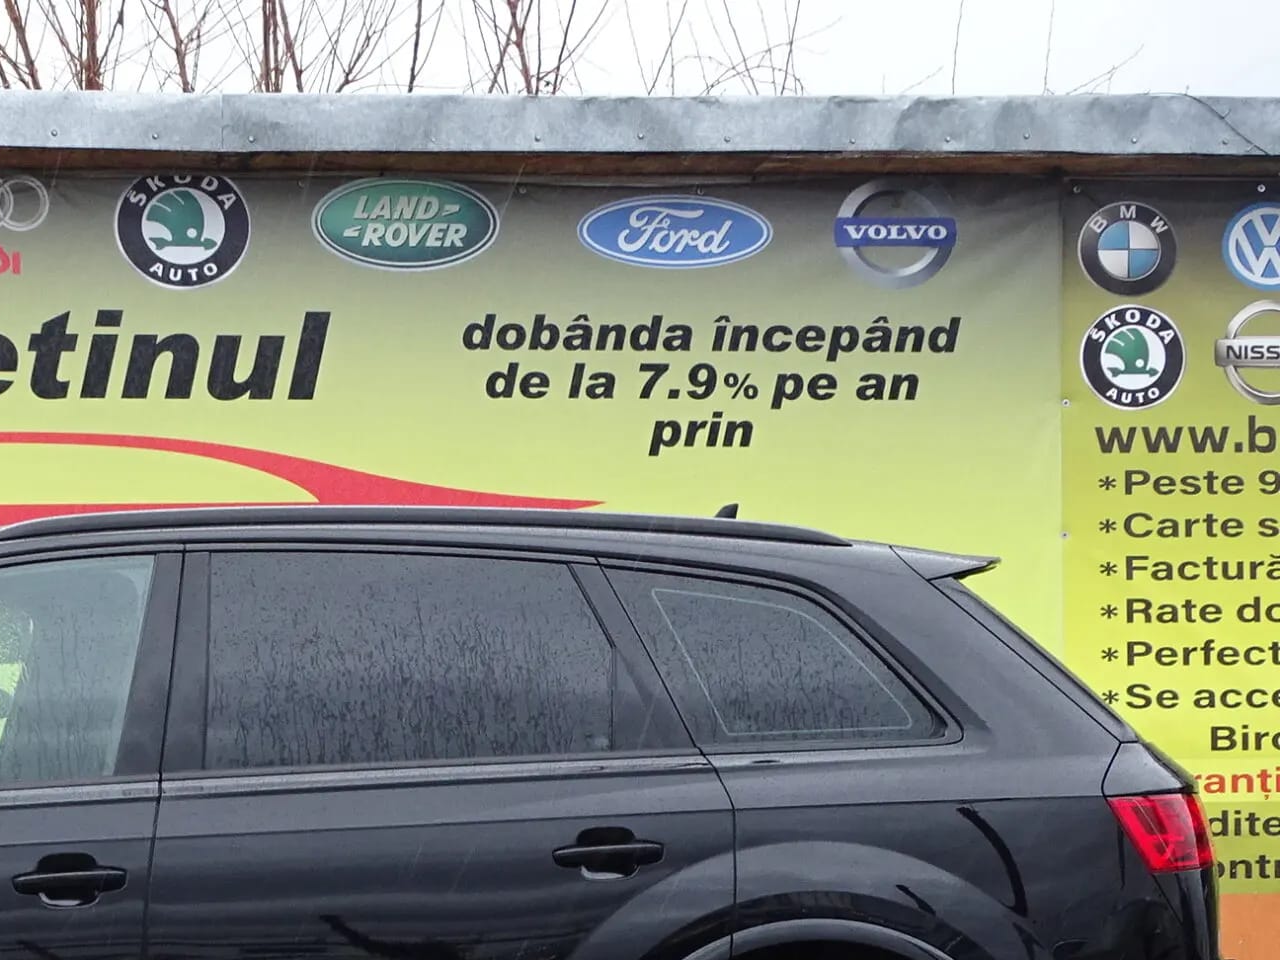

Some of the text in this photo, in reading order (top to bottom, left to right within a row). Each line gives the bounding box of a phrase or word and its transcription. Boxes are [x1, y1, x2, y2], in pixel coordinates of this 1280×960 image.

[353, 194, 439, 221] LAND
[1089, 205, 1169, 234] BMW
[360, 222, 468, 249] ROVER
[618, 204, 733, 256] Ford
[842, 224, 949, 242] VOLVO
[149, 262, 218, 282] AUTO
[461, 313, 961, 363] dobânda începând
[485, 361, 551, 399] de
[568, 362, 616, 399] la
[770, 371, 838, 410] pe
[857, 371, 920, 401] an
[1106, 386, 1161, 404] AUTO
[649, 411, 754, 457] prin
[1094, 415, 1277, 453] www.b
